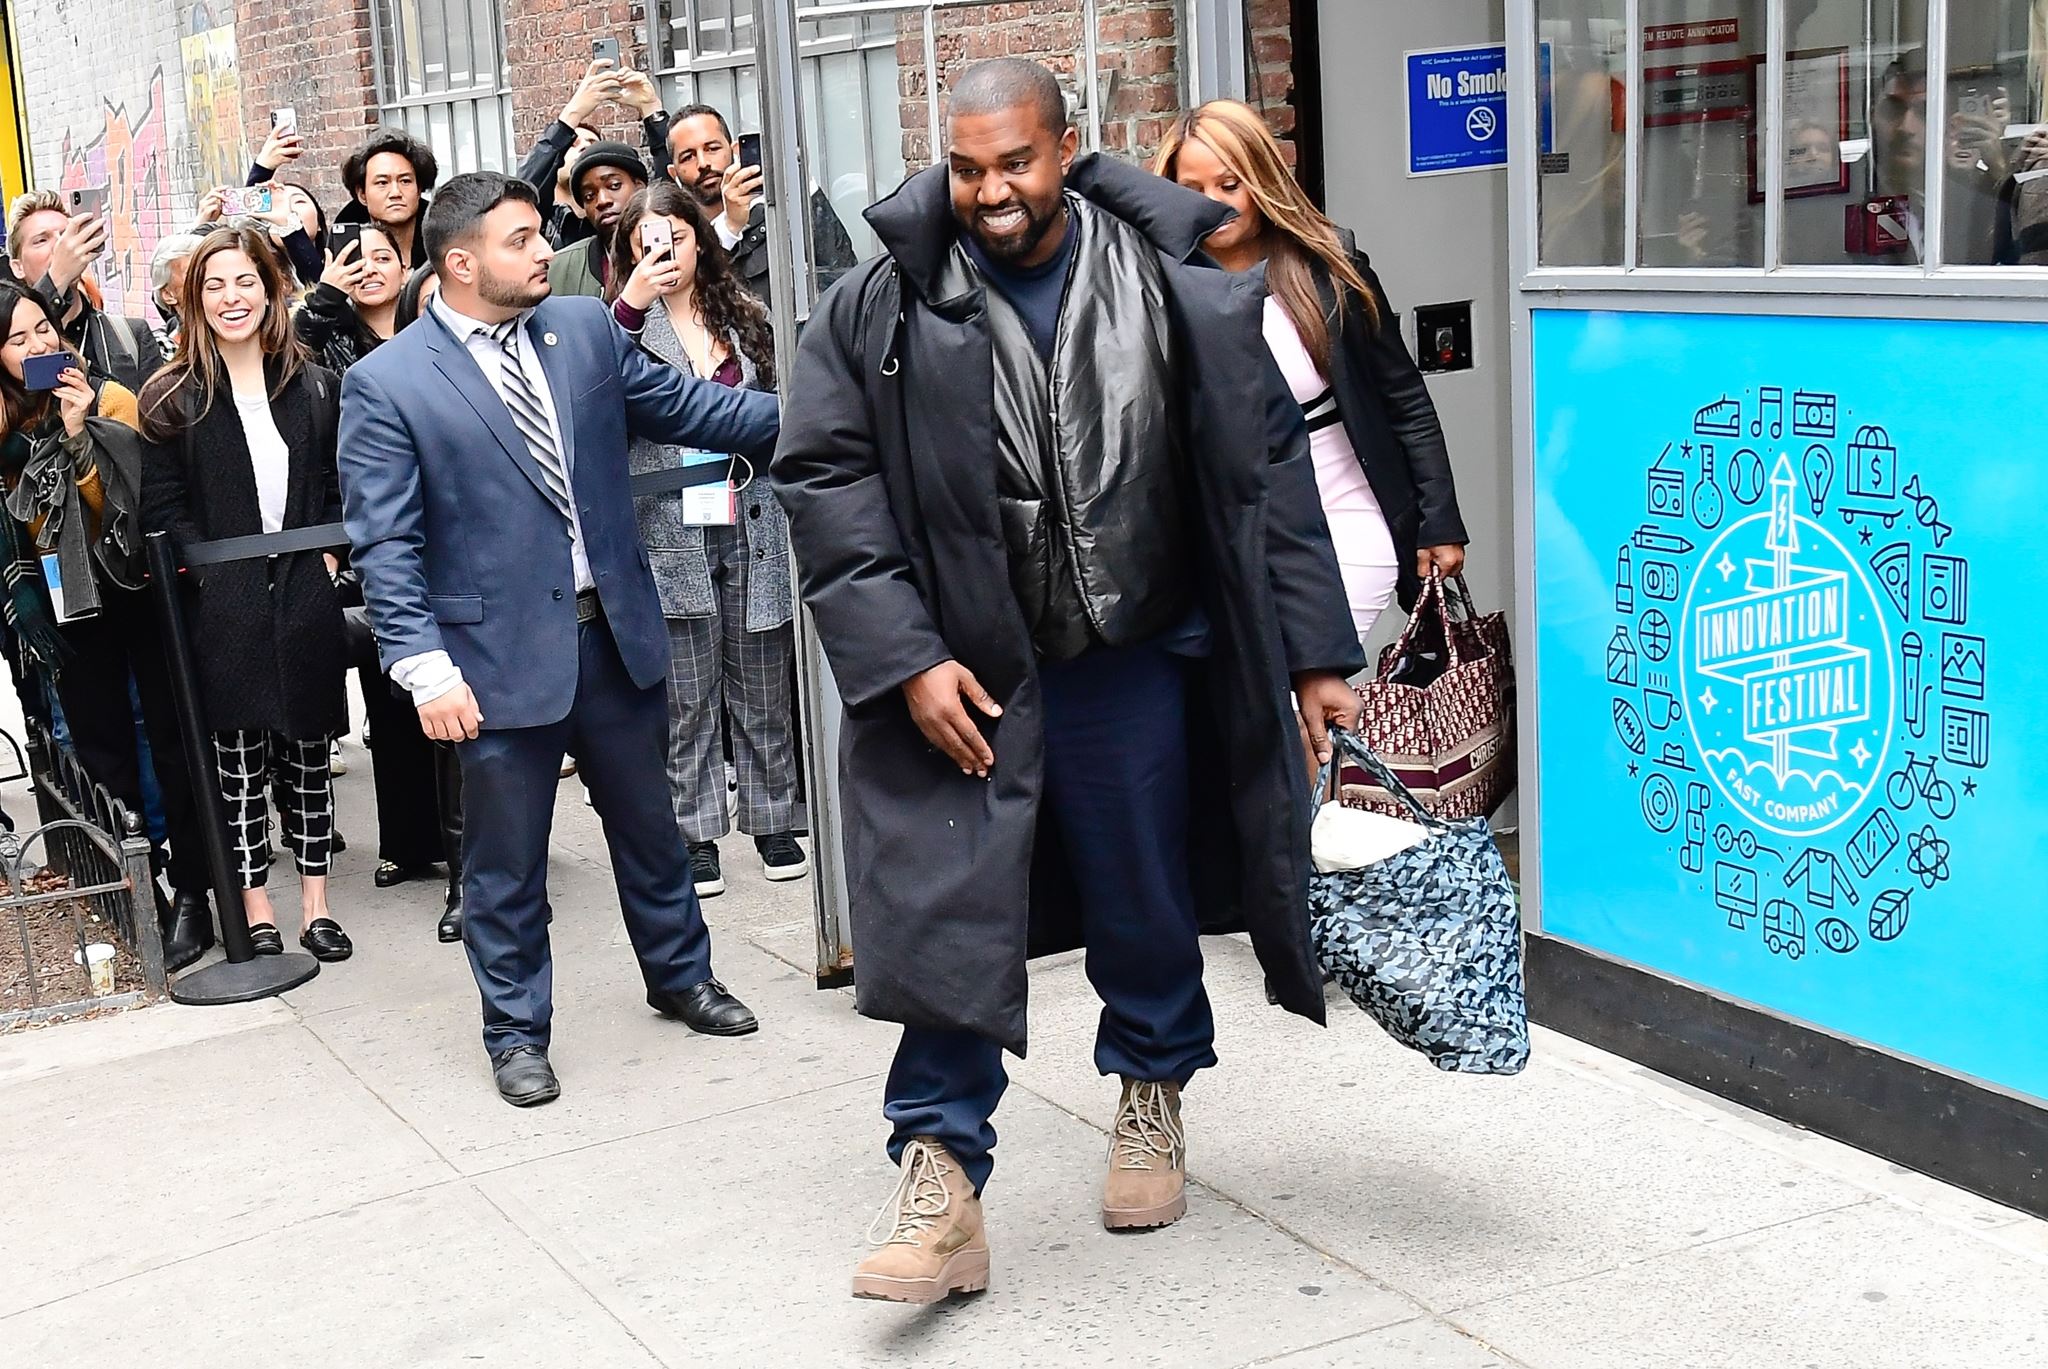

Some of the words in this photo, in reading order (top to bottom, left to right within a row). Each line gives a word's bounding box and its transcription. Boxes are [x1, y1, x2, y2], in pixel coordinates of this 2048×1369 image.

[1656, 28, 1685, 41] REMOTE
[1687, 23, 1736, 38] ANNUNCIATOR
[1427, 73, 1452, 99] No
[1703, 585, 1838, 660] INNOVATION
[1752, 664, 1859, 728] FESTIVAL
[1726, 767, 1761, 808] FAST
[1764, 791, 1840, 823] COMPANY
